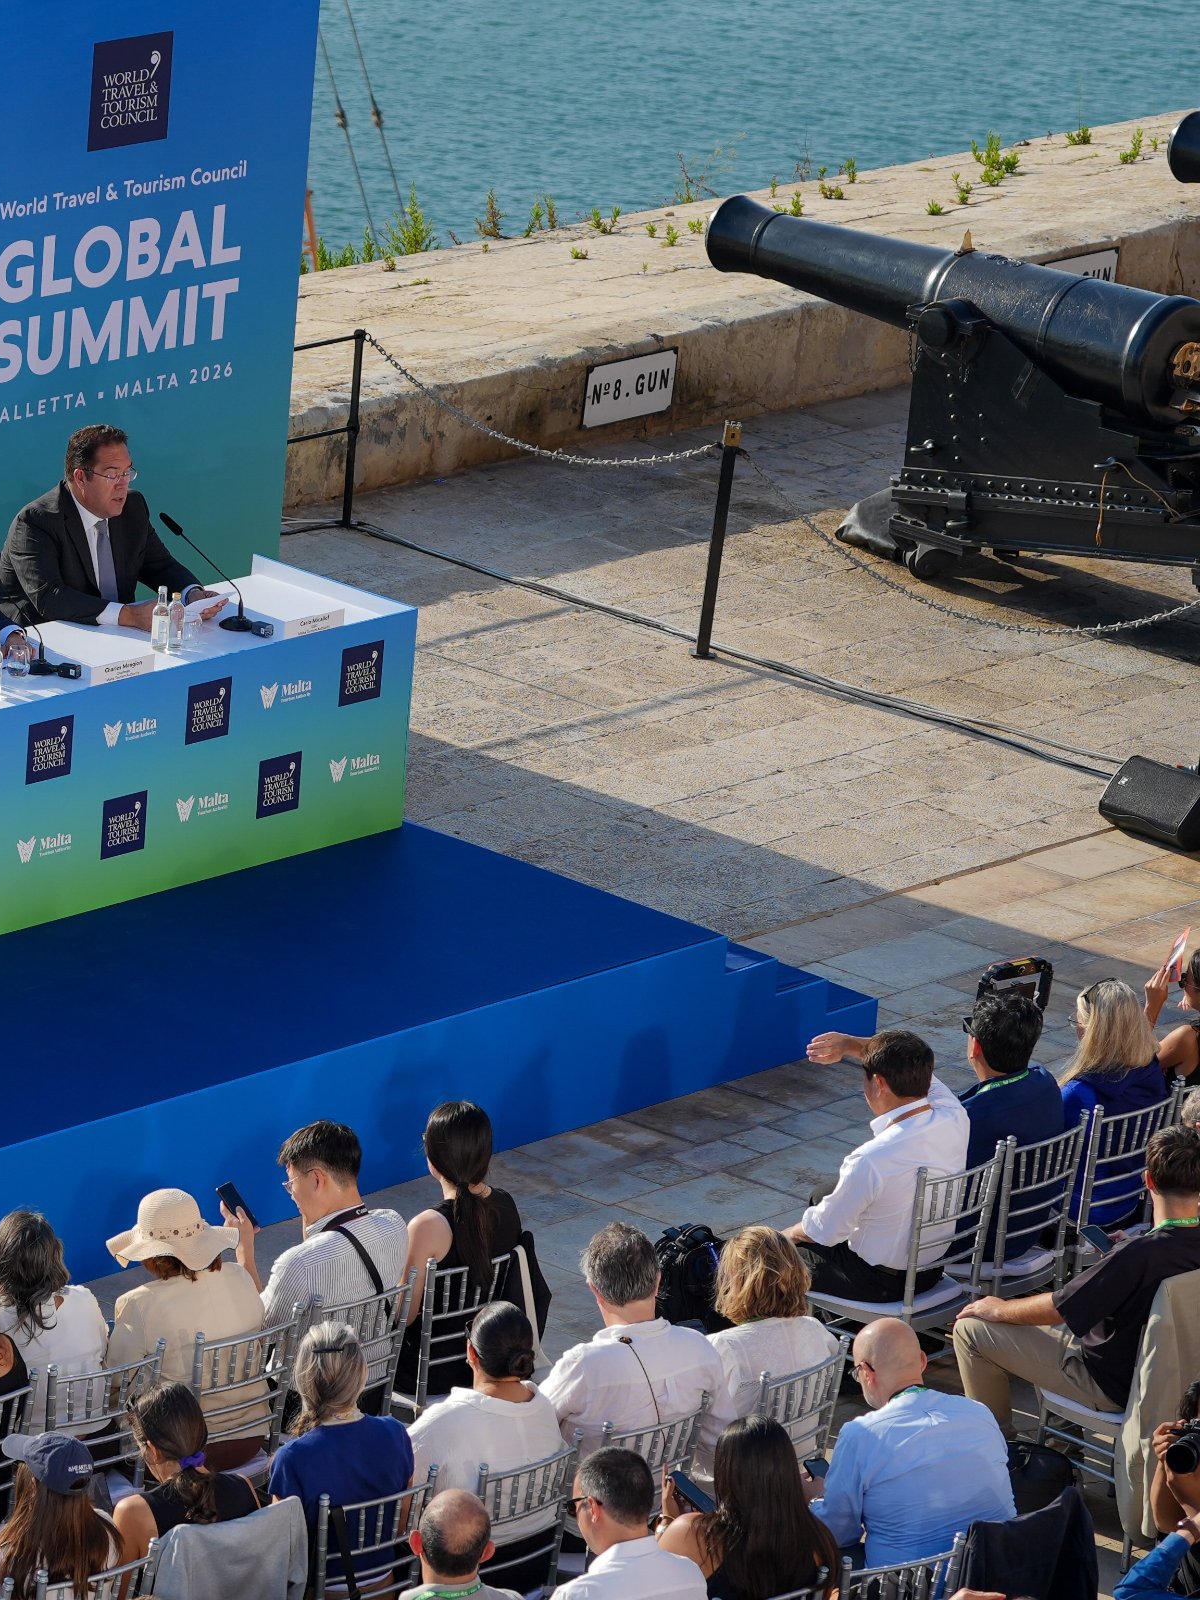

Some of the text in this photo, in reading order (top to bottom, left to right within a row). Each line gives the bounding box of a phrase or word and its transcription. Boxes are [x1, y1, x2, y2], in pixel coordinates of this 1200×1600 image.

[103, 68, 150, 88] WORLD
[101, 80, 159, 101] TRAVEL &
[101, 94, 158, 115] TOURISM
[100, 108, 158, 129] COUNCIL
[0, 160, 247, 220] World Travel & Tourism Council
[114, 373, 179, 400] MALTA
[189, 361, 234, 386] 2026
[635, 367, 670, 396] GUN
[346, 666, 376, 680] TRAVEL &
[347, 660, 372, 673] WORLD
[281, 680, 312, 697] Malta
[345, 674, 376, 688] TOURISM
[345, 681, 376, 695] COUNCIL
[192, 703, 224, 718] TRAVEL &
[193, 697, 219, 710] WORLD
[191, 718, 224, 733] COUNCIL
[192, 711, 224, 725] TOURISM
[125, 718, 157, 735] Malta
[33, 742, 66, 757] TRAVEL &
[34, 736, 61, 749] WORLD
[32, 750, 66, 765] TOURISM
[32, 757, 66, 772] COUNCIL
[350, 754, 380, 771] Malta
[263, 777, 294, 792] TRAVEL &
[264, 771, 290, 785] WORLD
[262, 792, 294, 807] COUNCIL
[263, 785, 294, 800] TOURISM
[197, 793, 229, 810] Malta
[107, 817, 140, 832] TRAVEL &
[108, 811, 135, 825] WORLD
[107, 825, 140, 840] TOURISM
[107, 832, 140, 847] COUNCIL
[39, 833, 72, 851] Malta
